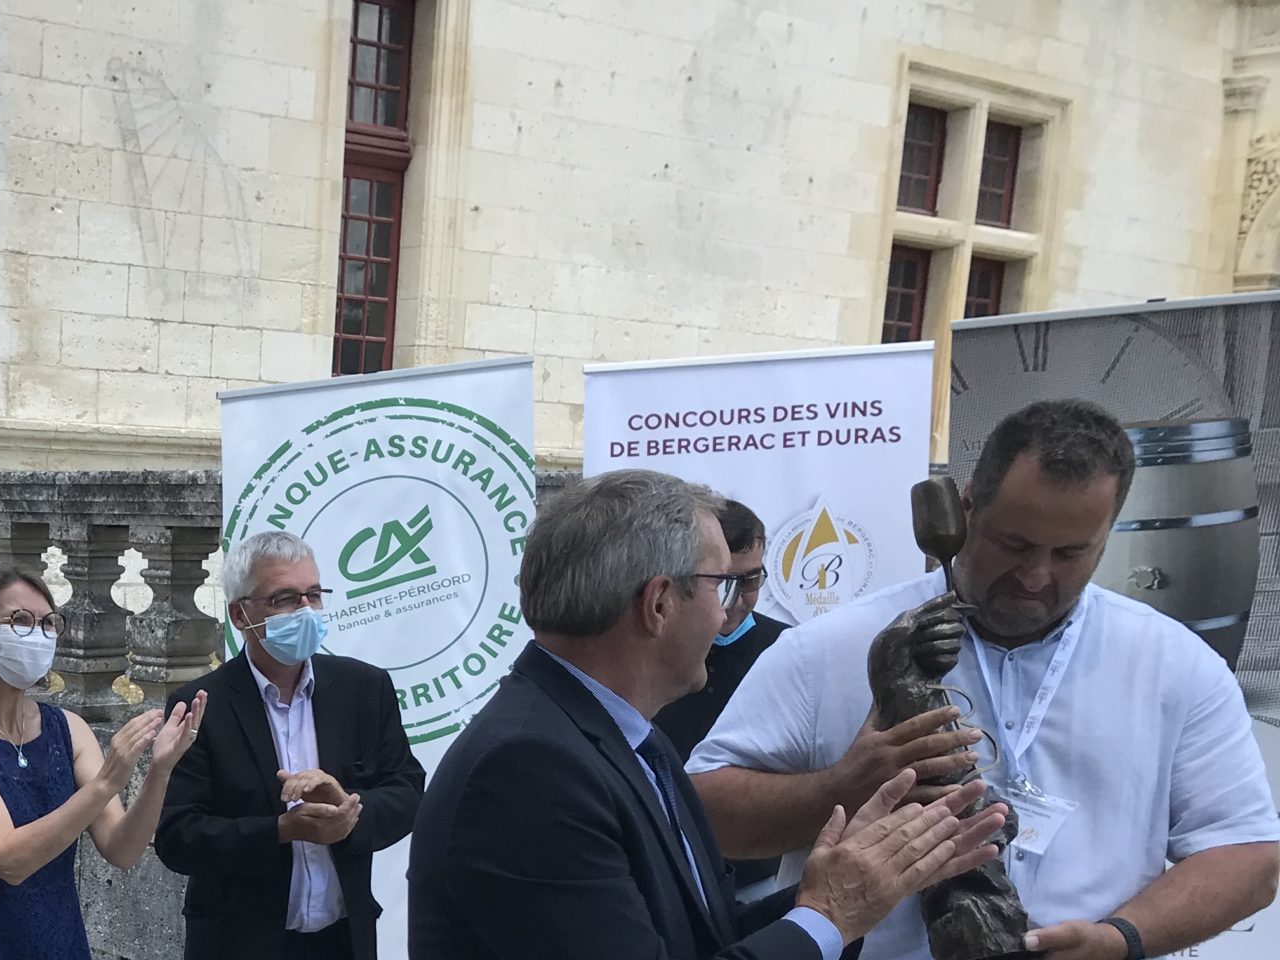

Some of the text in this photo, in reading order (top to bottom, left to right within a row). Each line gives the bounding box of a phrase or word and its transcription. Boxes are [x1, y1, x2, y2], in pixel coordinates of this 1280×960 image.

[627, 400, 883, 431] CONCOURS DES VINS
[610, 426, 902, 458] DE BERGERAC ET DURAS
[266, 434, 528, 556] NQUE-ASSURANCE
[321, 573, 472, 624] CHARENTE-PÉRIGORD
[338, 591, 459, 632] banque & assurances
[805, 591, 840, 606] Médaille
[395, 602, 521, 710] RRITOIRE
